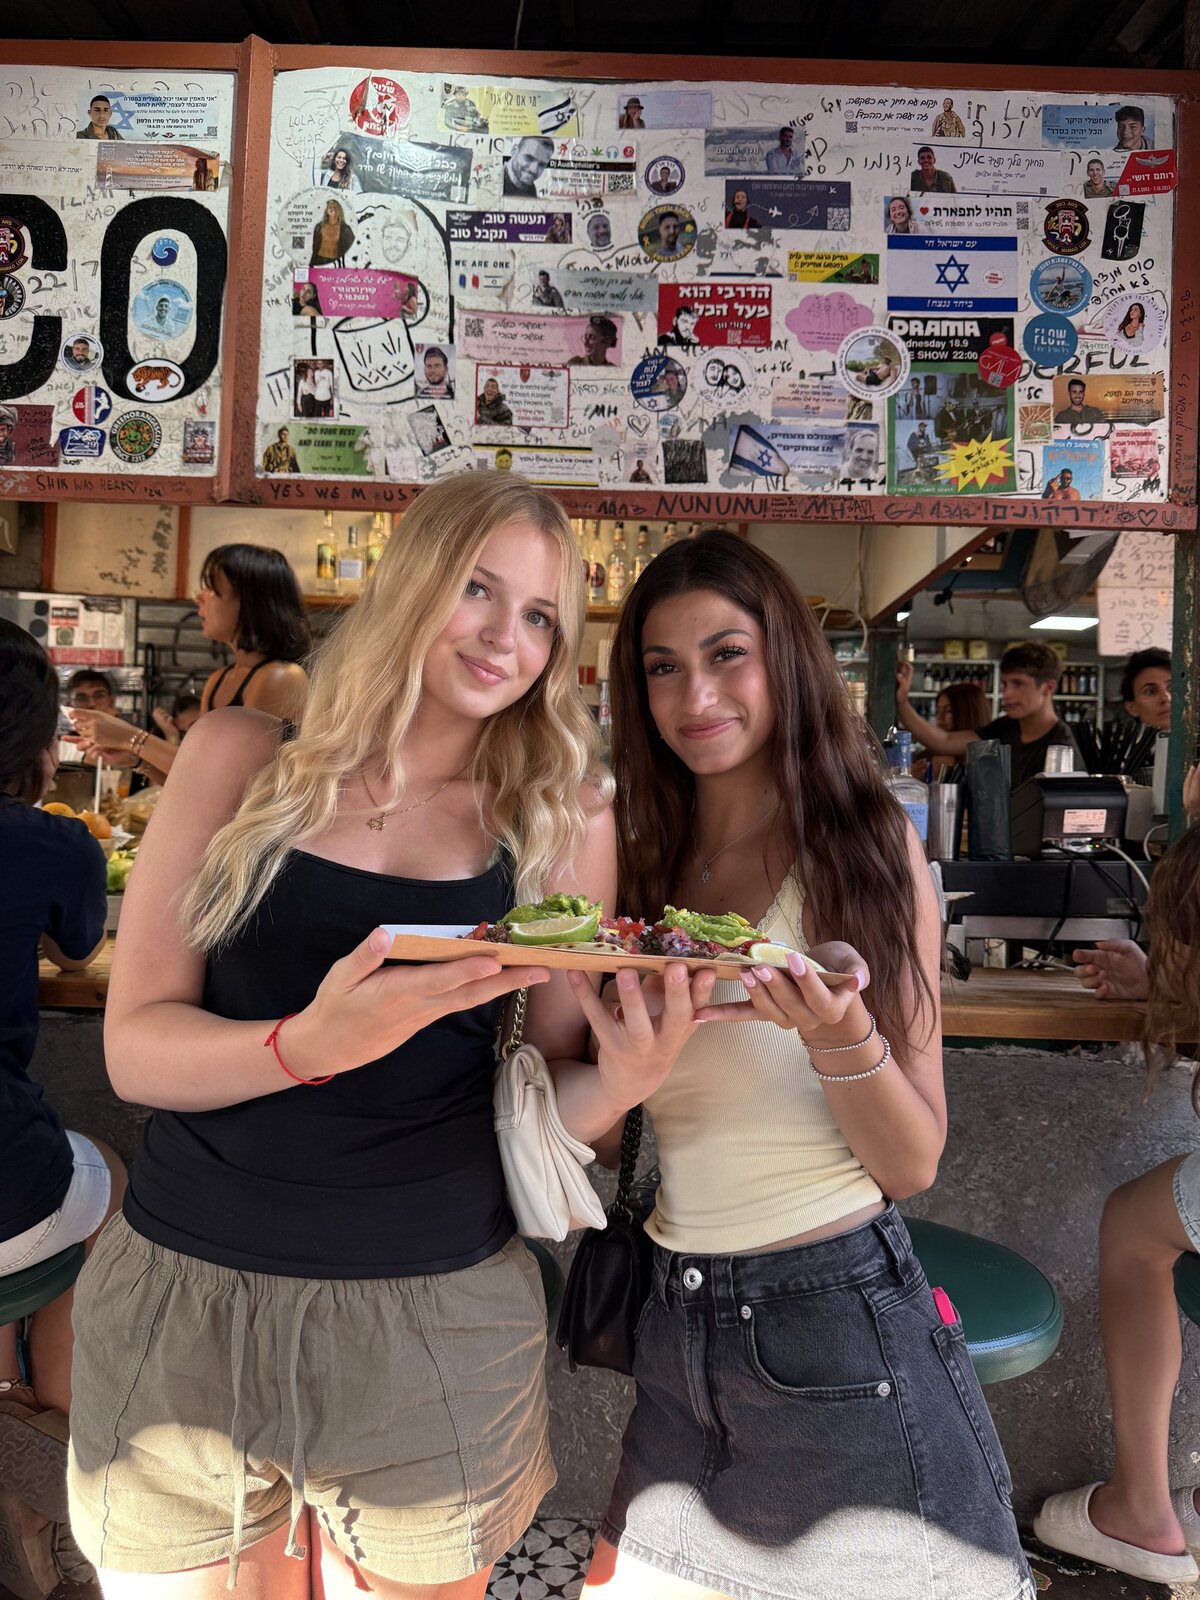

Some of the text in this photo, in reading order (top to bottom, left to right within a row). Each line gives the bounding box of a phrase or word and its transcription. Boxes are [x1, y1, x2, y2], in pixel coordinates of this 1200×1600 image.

[908, 98, 919, 106] עם
[917, 113, 929, 121] זה
[1153, 172, 1174, 180] רותם
[933, 204, 1012, 217] תהיו לתפארת
[509, 214, 546, 225] תעשה
[450, 226, 507, 242] תקבל טוב
[937, 238, 963, 248] ישראל
[965, 240, 977, 248] עם
[454, 259, 510, 269] WE ARE ONE
[679, 285, 771, 299] הדרבי הוא
[953, 300, 974, 308] ביחד
[694, 302, 770, 319] מעל הכל
[892, 319, 981, 337] DRAMA
[905, 339, 969, 349] dnesday 18.9
[917, 351, 979, 360] SHOW 22:00
[73, 479, 93, 491] WAS
[271, 483, 304, 498] YES
[315, 487, 340, 499] WE
